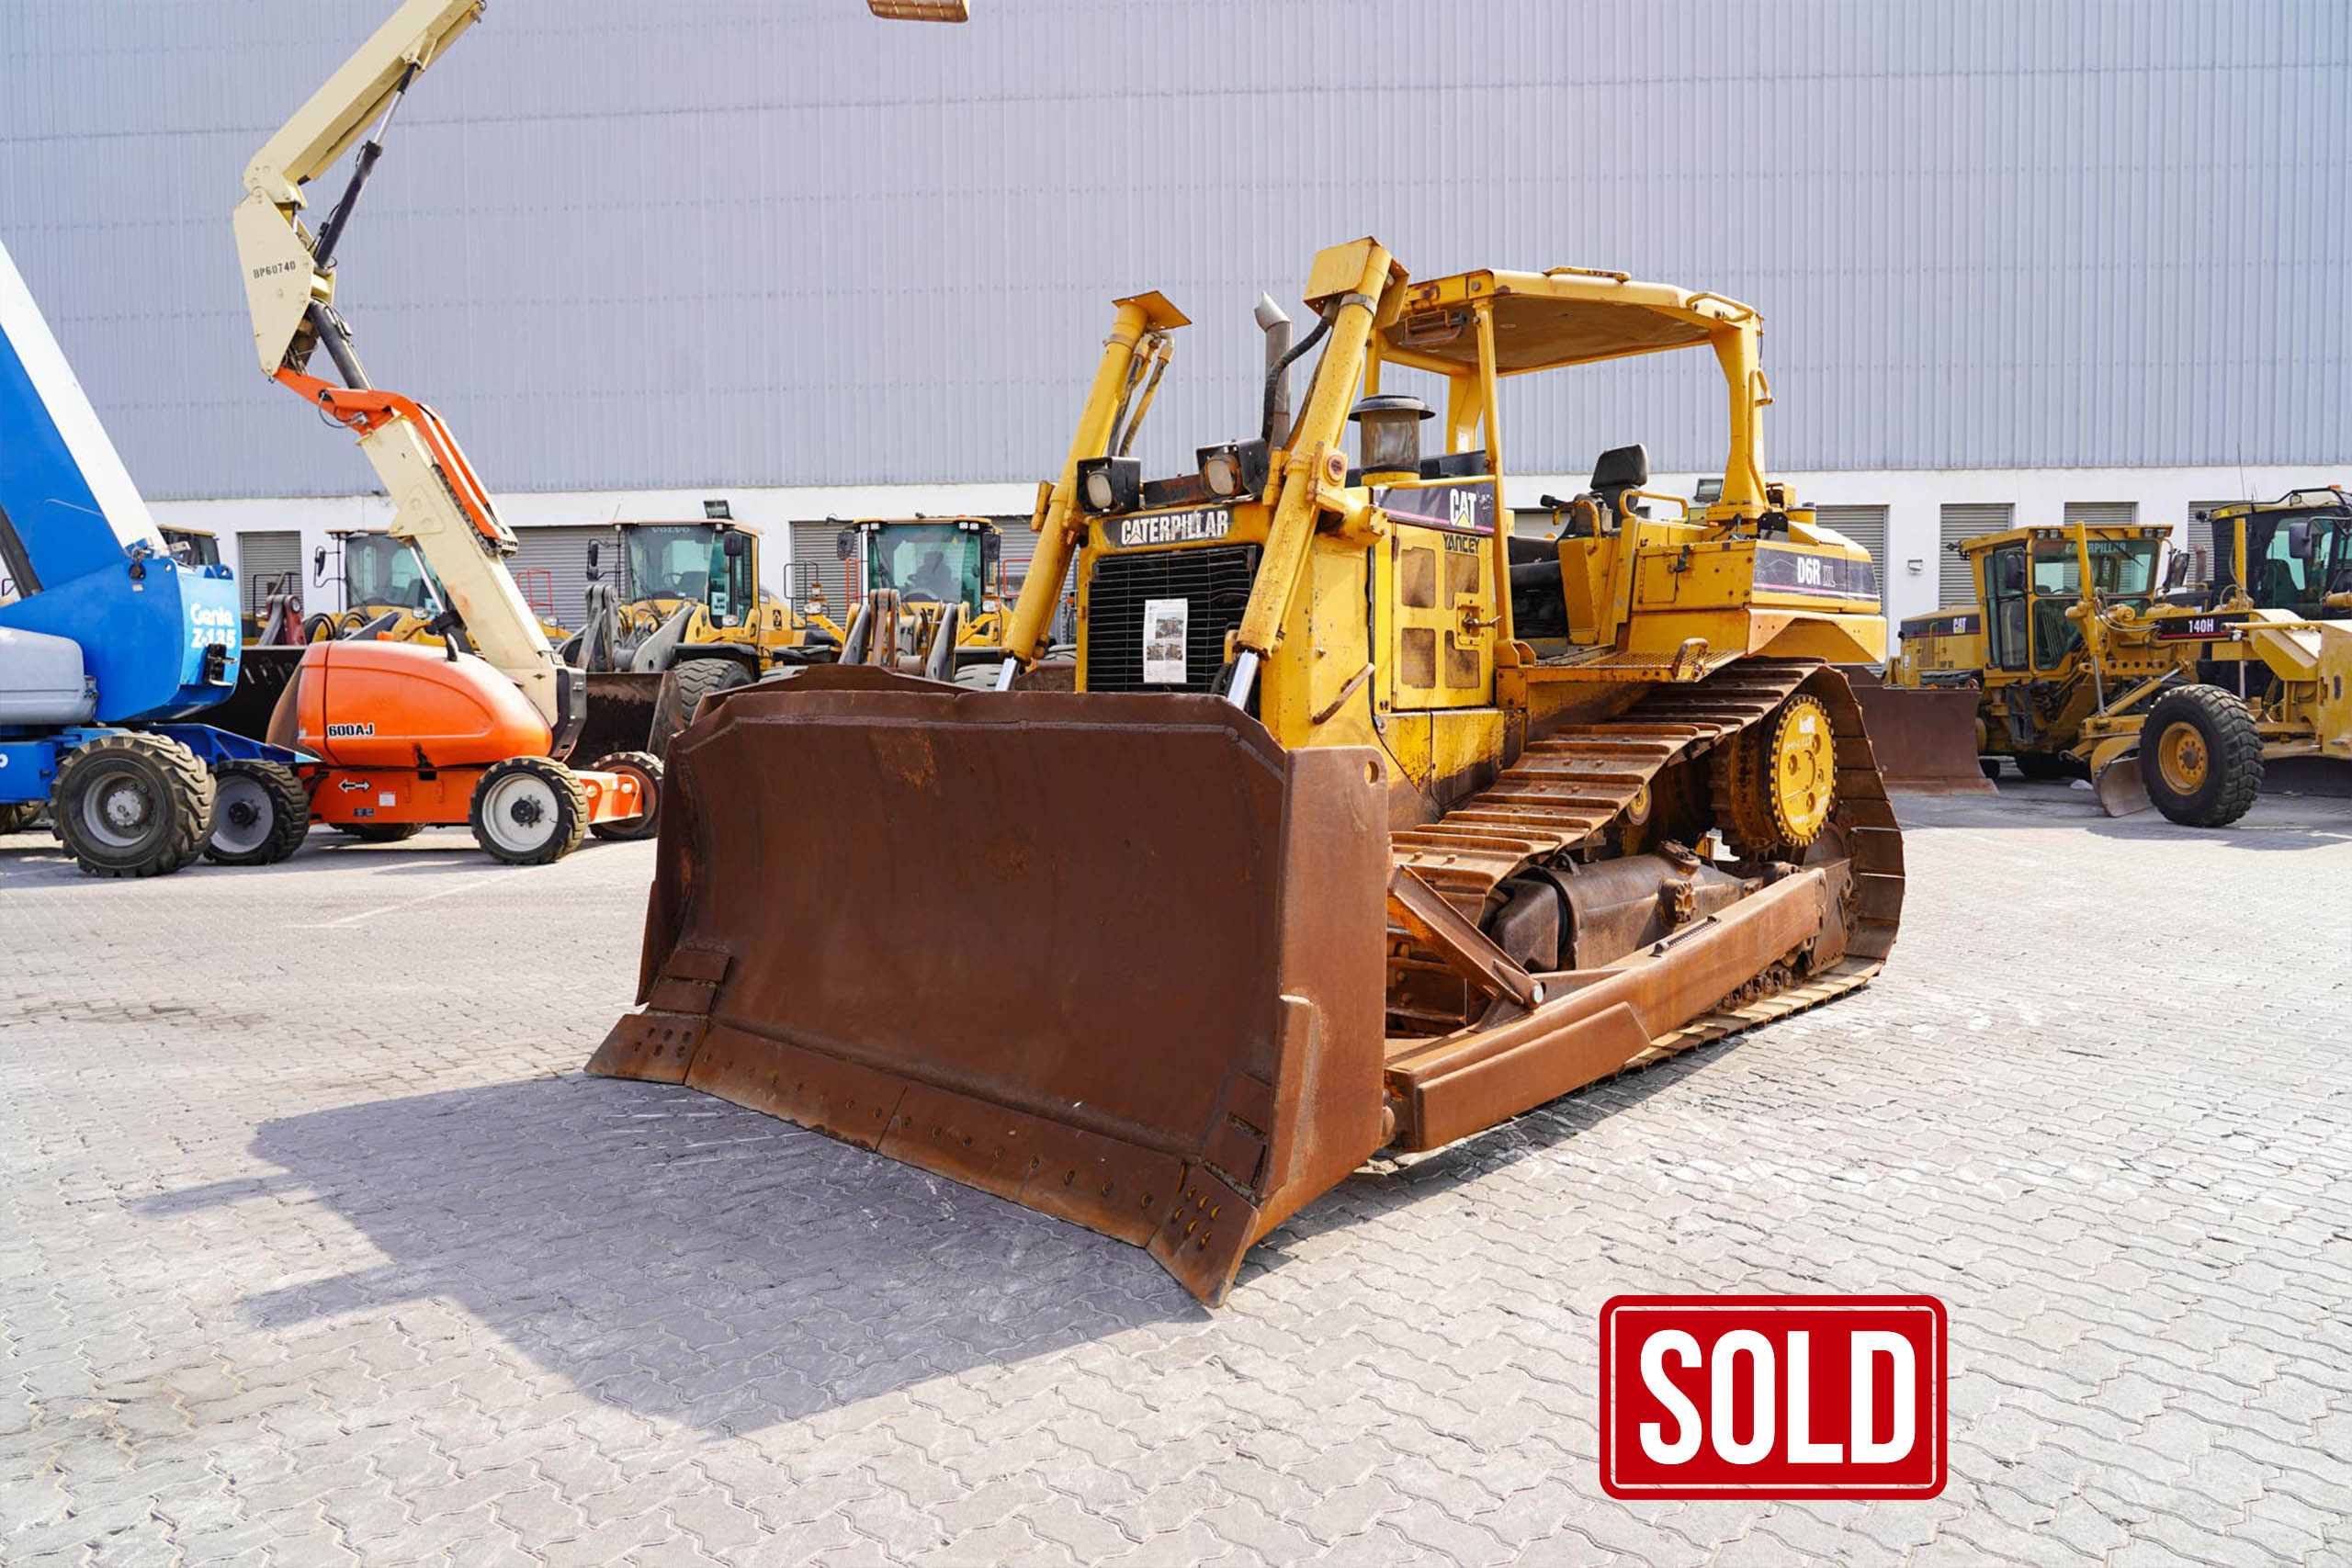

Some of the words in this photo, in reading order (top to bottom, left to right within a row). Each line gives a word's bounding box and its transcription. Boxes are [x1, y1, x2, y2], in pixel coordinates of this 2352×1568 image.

[253, 260, 296, 279] BP60740
[1450, 488, 1476, 529] CAT
[1121, 510, 1228, 545] CATERPILLAR
[1442, 534, 1480, 554] YANCEY
[1797, 557, 1821, 585] D6R
[190, 603, 235, 626] Genie
[1953, 616, 1967, 634] CAT
[2188, 618, 2214, 633] 140H
[328, 723, 374, 737] 600AJ
